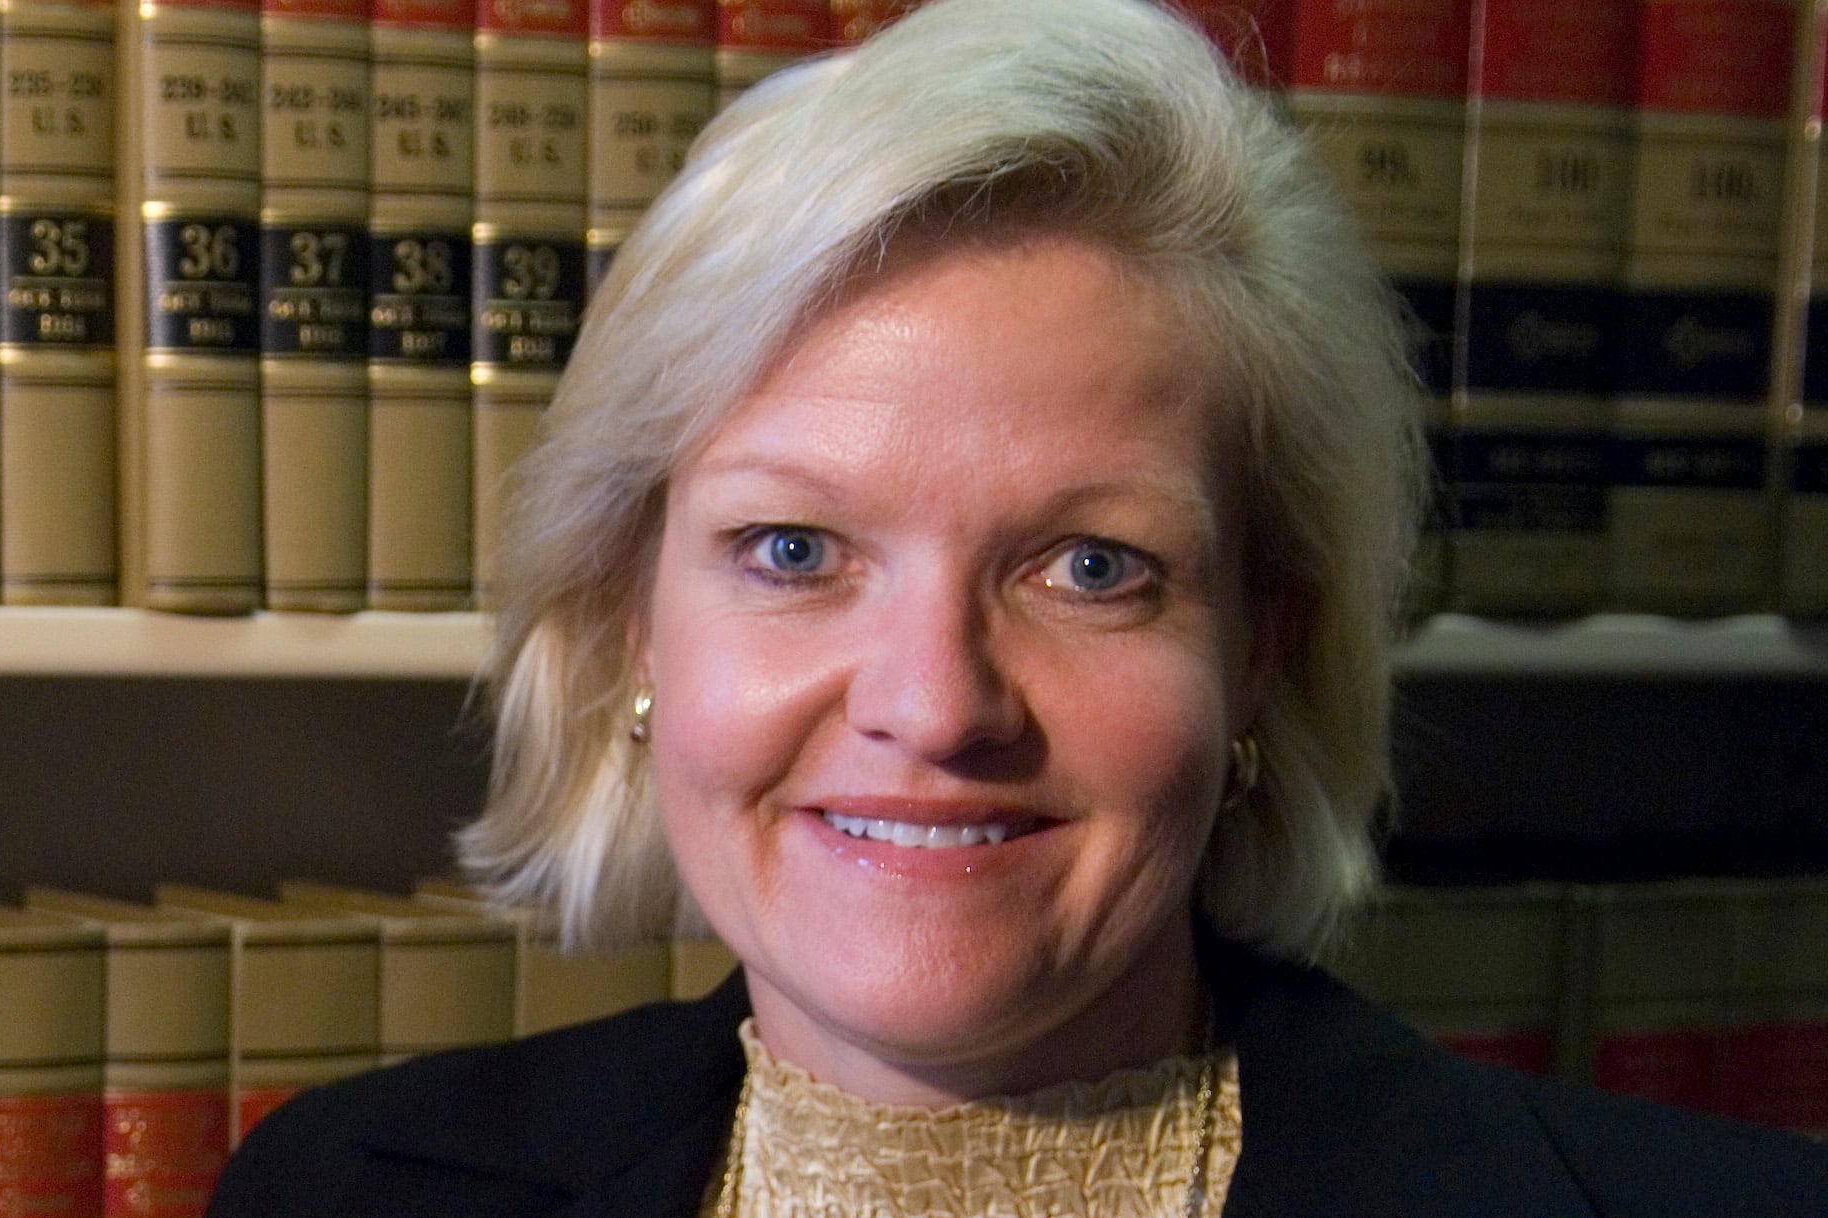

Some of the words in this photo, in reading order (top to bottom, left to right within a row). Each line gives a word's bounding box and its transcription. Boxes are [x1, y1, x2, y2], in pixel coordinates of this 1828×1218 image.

[29, 219, 91, 275] 35
[179, 224, 240, 280] 36
[290, 230, 350, 288] 37
[392, 238, 452, 295] 38
[502, 246, 561, 302] 39
